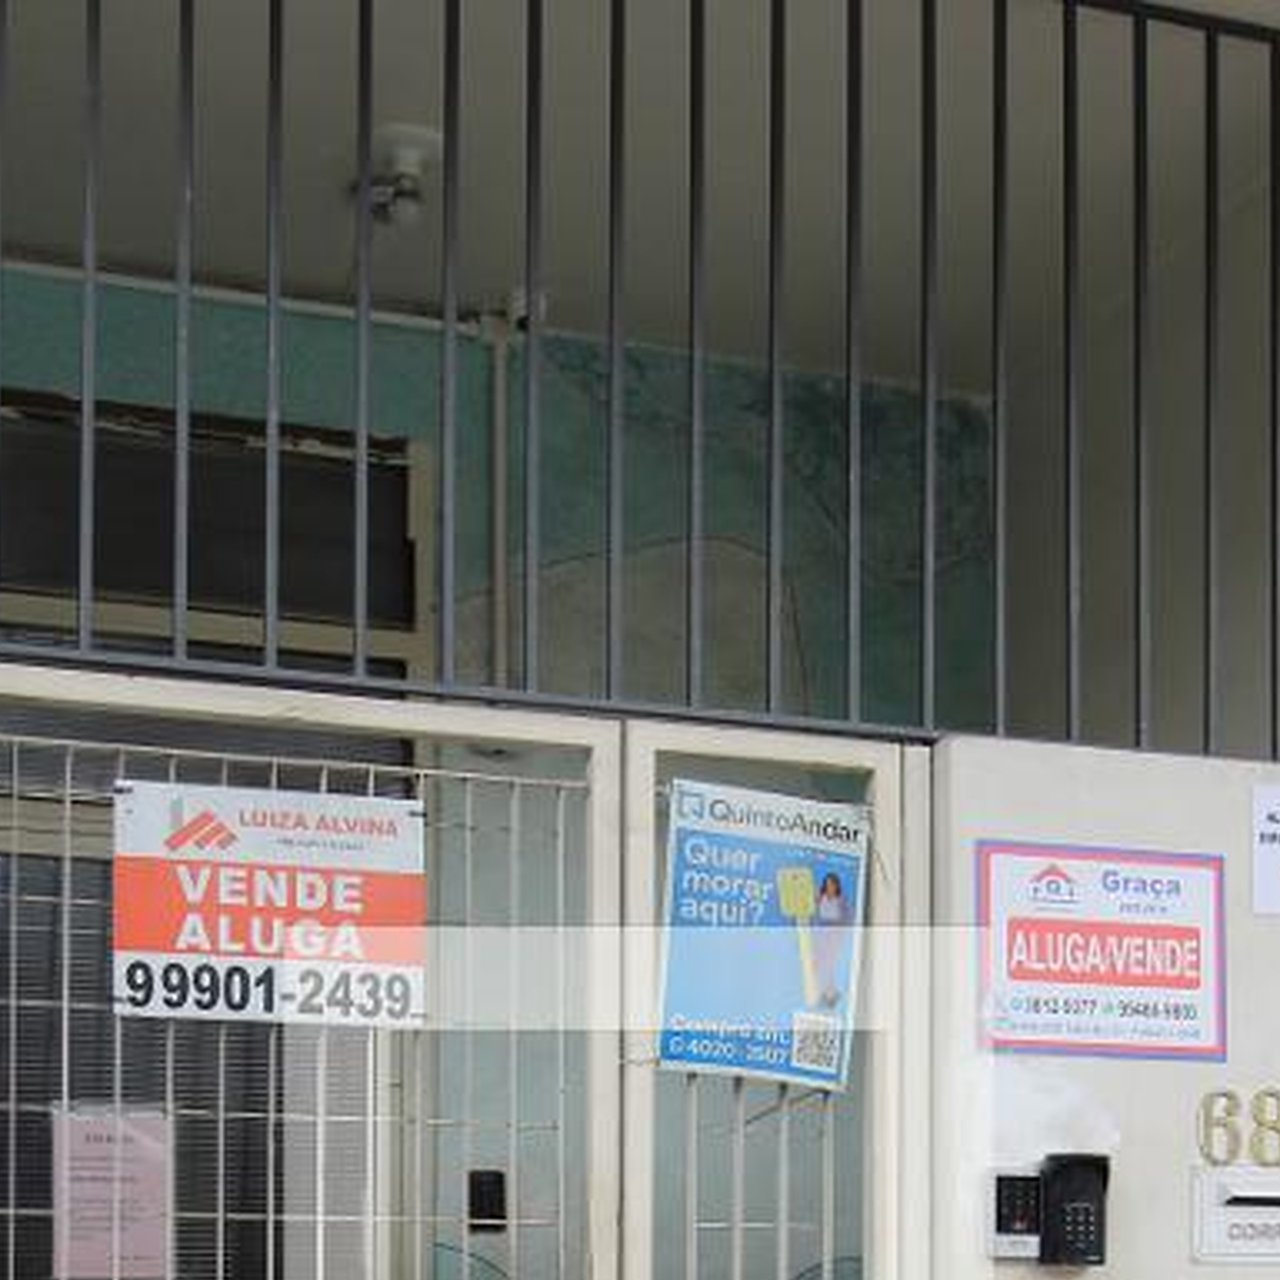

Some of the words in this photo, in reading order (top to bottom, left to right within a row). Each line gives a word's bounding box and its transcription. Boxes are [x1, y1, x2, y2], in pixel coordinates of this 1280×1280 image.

[238, 808, 310, 832] LUIZA
[315, 812, 398, 839] ALVINA
[708, 798, 860, 844] QuintoAndar
[683, 838, 761, 874] Quer
[175, 864, 365, 914] VENDE
[681, 869, 773, 901] morar
[1101, 870, 1182, 899] Graça
[678, 897, 765, 927] aqui?
[175, 912, 365, 960] ALUGA
[125, 960, 412, 1019] 99901-2439
